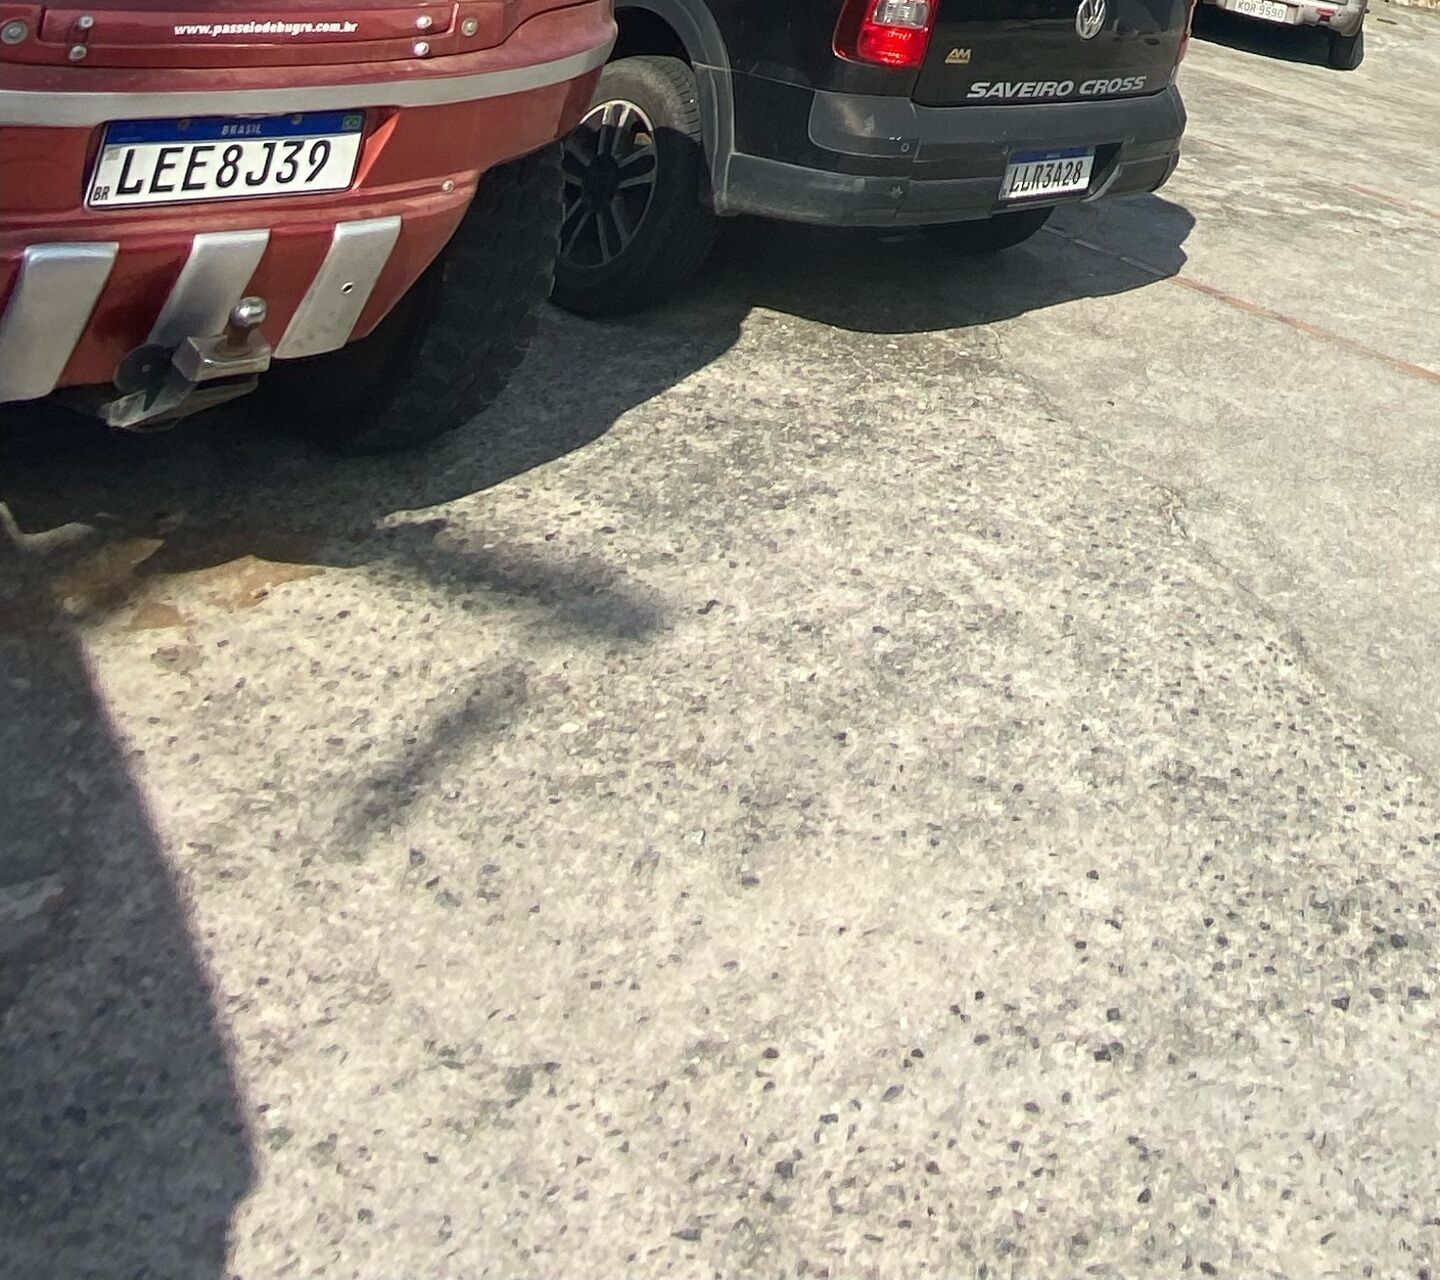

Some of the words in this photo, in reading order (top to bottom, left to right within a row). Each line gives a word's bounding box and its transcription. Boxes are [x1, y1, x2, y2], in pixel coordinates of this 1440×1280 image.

[967, 80, 1075, 99] SAVEIRO
[1079, 76, 1147, 95] CROSS
[221, 124, 262, 136] BRASIL
[115, 140, 331, 195] LEE8J39
[93, 186, 110, 201] BR
